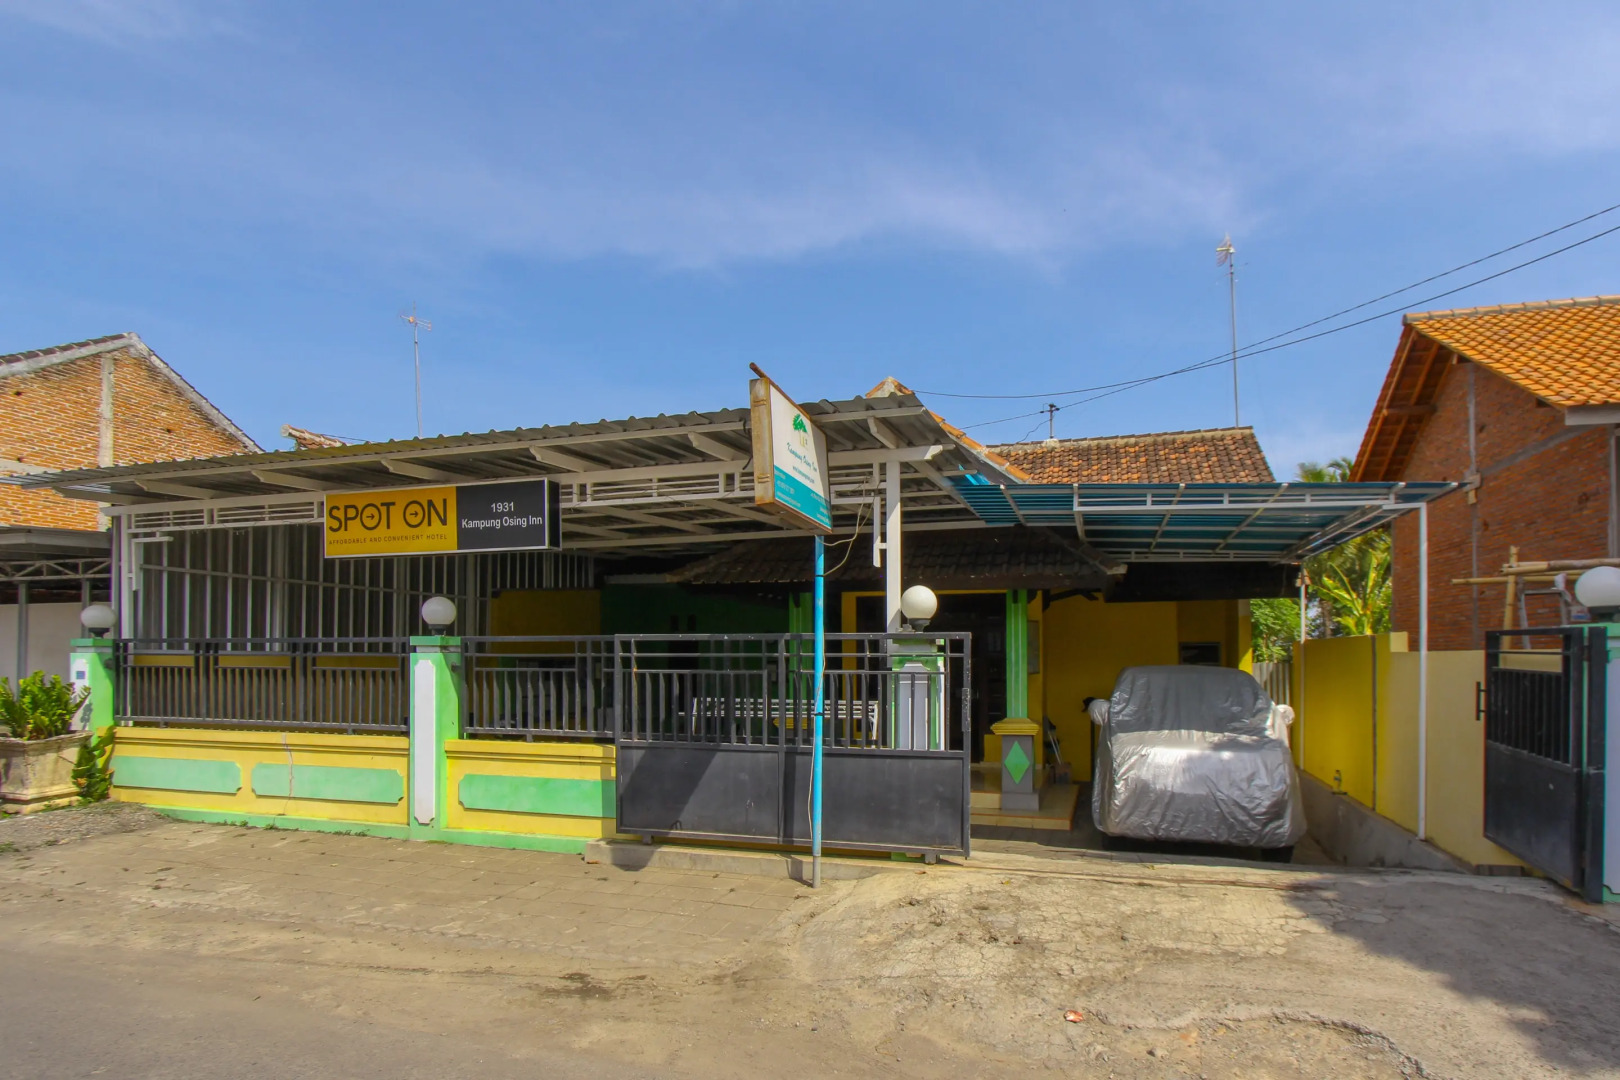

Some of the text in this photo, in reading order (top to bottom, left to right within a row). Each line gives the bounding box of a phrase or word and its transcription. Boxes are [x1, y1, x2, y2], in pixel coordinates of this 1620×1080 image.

[491, 501, 514, 512] 1931
[328, 498, 448, 532] SPOT ON
[461, 515, 542, 530] Kampung Osing Inn
[329, 537, 367, 545] AFFORDABLE
[383, 534, 424, 542] CONVENIENT
